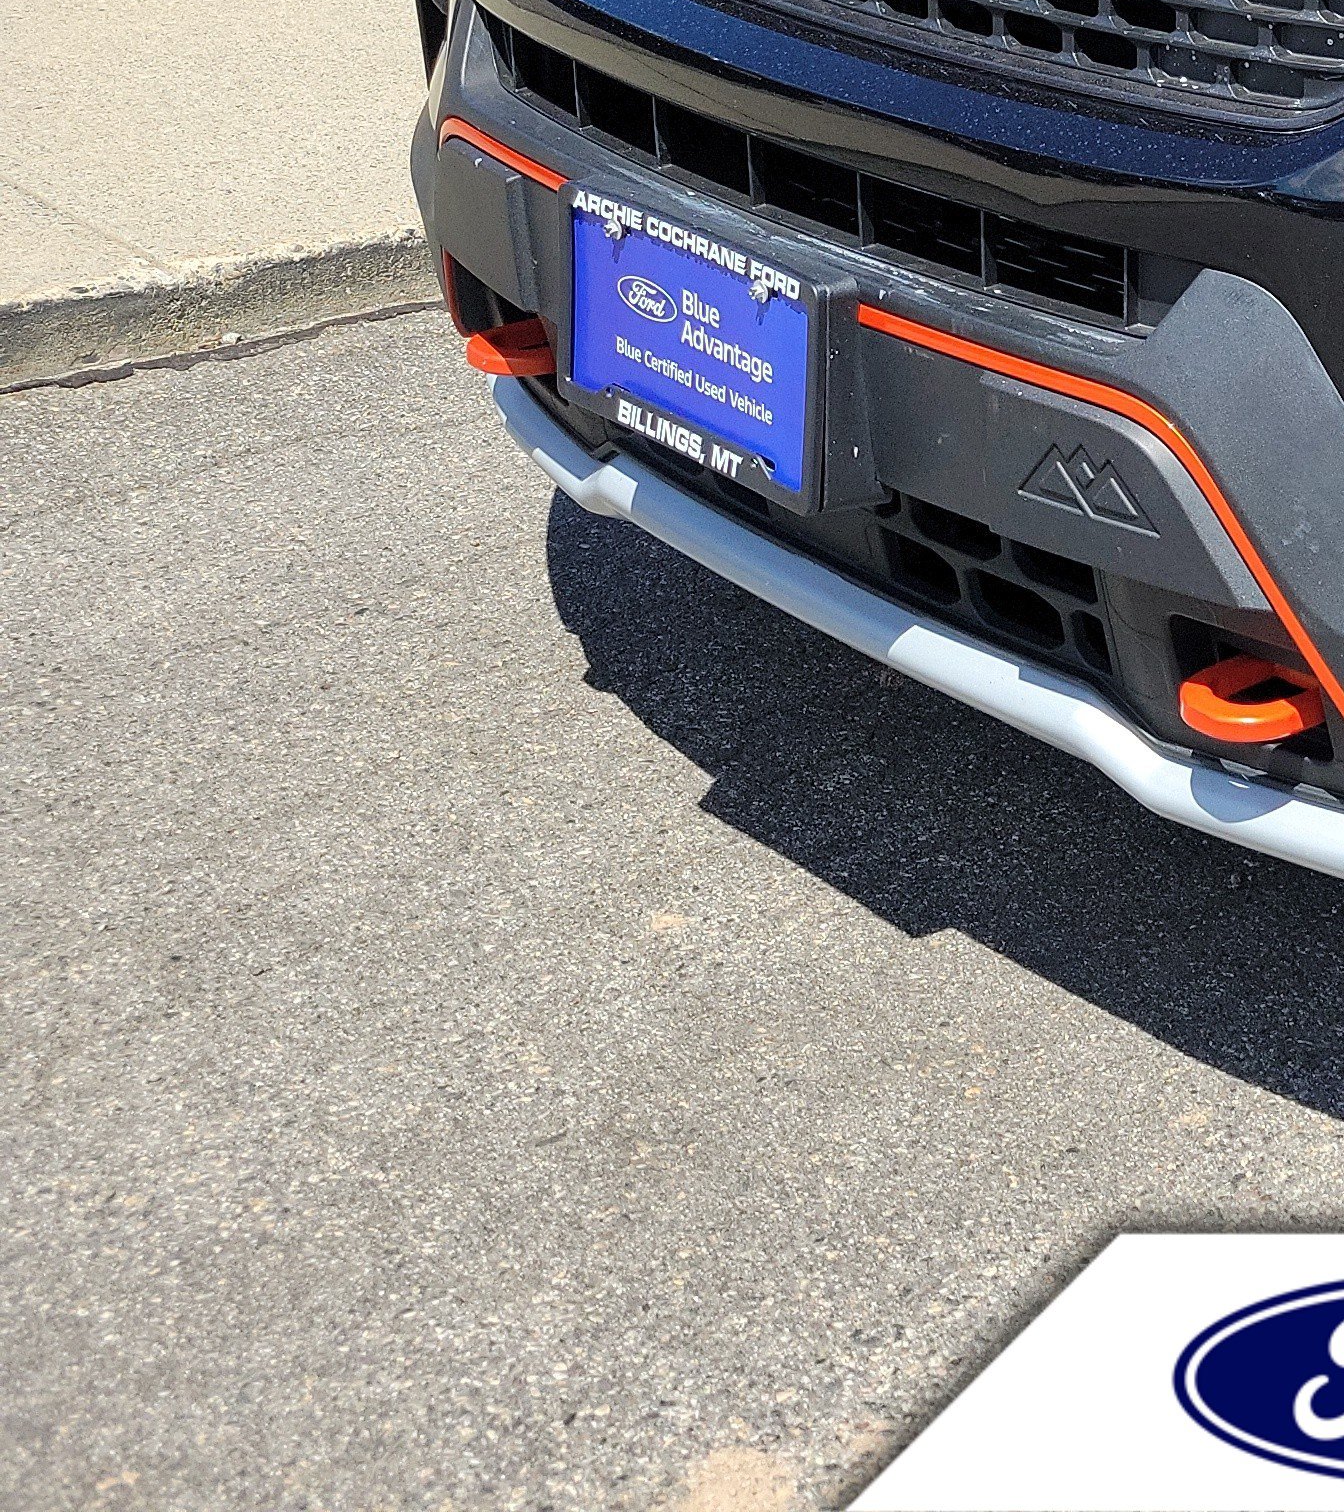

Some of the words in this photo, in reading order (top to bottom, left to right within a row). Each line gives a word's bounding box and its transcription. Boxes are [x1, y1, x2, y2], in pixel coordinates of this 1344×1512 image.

[572, 190, 644, 231] ARCHIE
[646, 216, 748, 276] COCHRANE
[749, 258, 801, 300] FORD
[628, 280, 666, 318] Ford
[681, 288, 720, 329] Blue
[615, 335, 642, 363] Blue
[643, 350, 693, 388] Certified
[694, 373, 726, 404] Used
[729, 388, 773, 426] Vehicle
[680, 319, 773, 384] Advantage
[617, 398, 706, 464] BILLINGS,
[710, 443, 744, 479] MT
